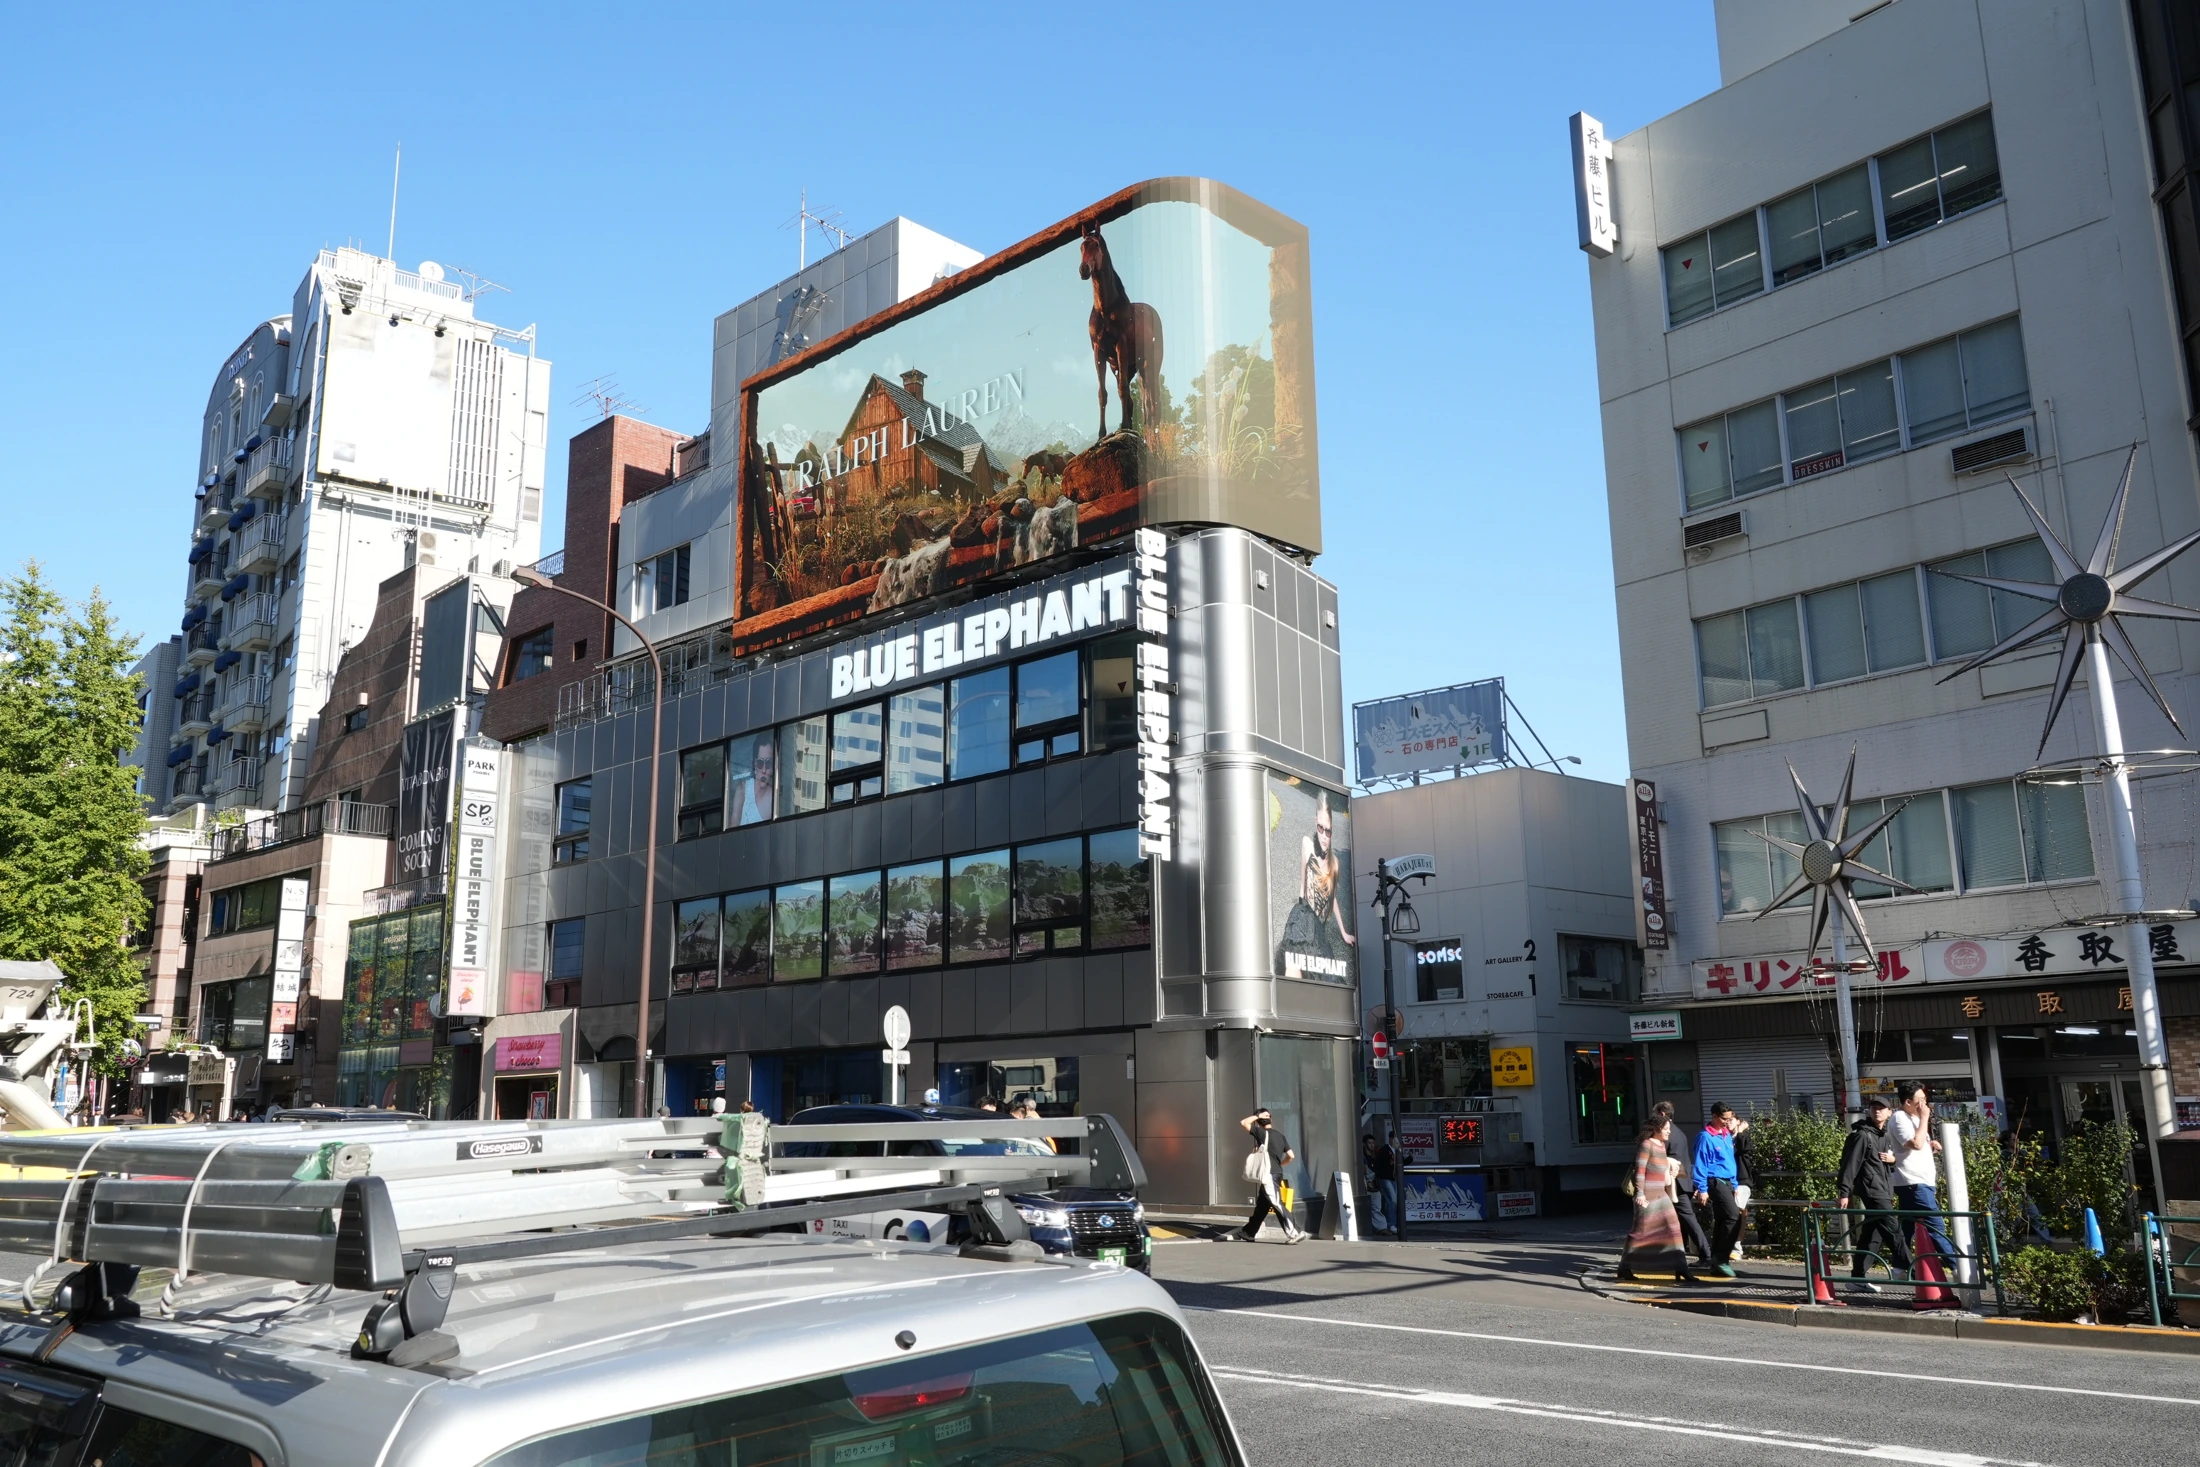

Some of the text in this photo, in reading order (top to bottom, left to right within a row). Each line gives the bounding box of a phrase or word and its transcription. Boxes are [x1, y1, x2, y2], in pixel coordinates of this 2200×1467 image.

[798, 367, 1025, 492] RALPH LAUREN
[1794, 456, 1841, 479] DRESSKIN
[831, 569, 1131, 700] BLUE ELEPHANT
[1138, 527, 1171, 862] BLUE ELEPHANT
[1473, 743, 1491, 756] 1F
[468, 759, 496, 771] PARK
[465, 803, 492, 818] SP
[399, 826, 442, 853] COMING
[1639, 816, 1649, 872] 東京センター
[1646, 807, 1657, 868] ハーモニー
[404, 849, 433, 872] SOON
[469, 837, 484, 878] BLUE
[1395, 858, 1425, 876] HARAJUKU
[463, 881, 481, 966] ELEPHANT
[1523, 939, 1537, 962] 2
[2014, 923, 2186, 973] 香取屋
[1285, 951, 1347, 977] BLUE ELEPHANT
[1497, 955, 1523, 964] GALLERY
[8, 987, 36, 1000] 724
[1487, 990, 1524, 999] STORE&CAFE
[1528, 974, 1536, 996] 1
[1960, 987, 2135, 1019] 香取屋
[508, 1039, 546, 1055] Strawberry
[1446, 1121, 1477, 1131] ダイヤ
[1446, 1131, 1476, 1142] モンド
[474, 1141, 526, 1155] Hasegawa
[1416, 1201, 1475, 1210] コスモスペース
[833, 1219, 848, 1229] TAXI
[835, 1442, 886, 1459] 片切りスイッチ
